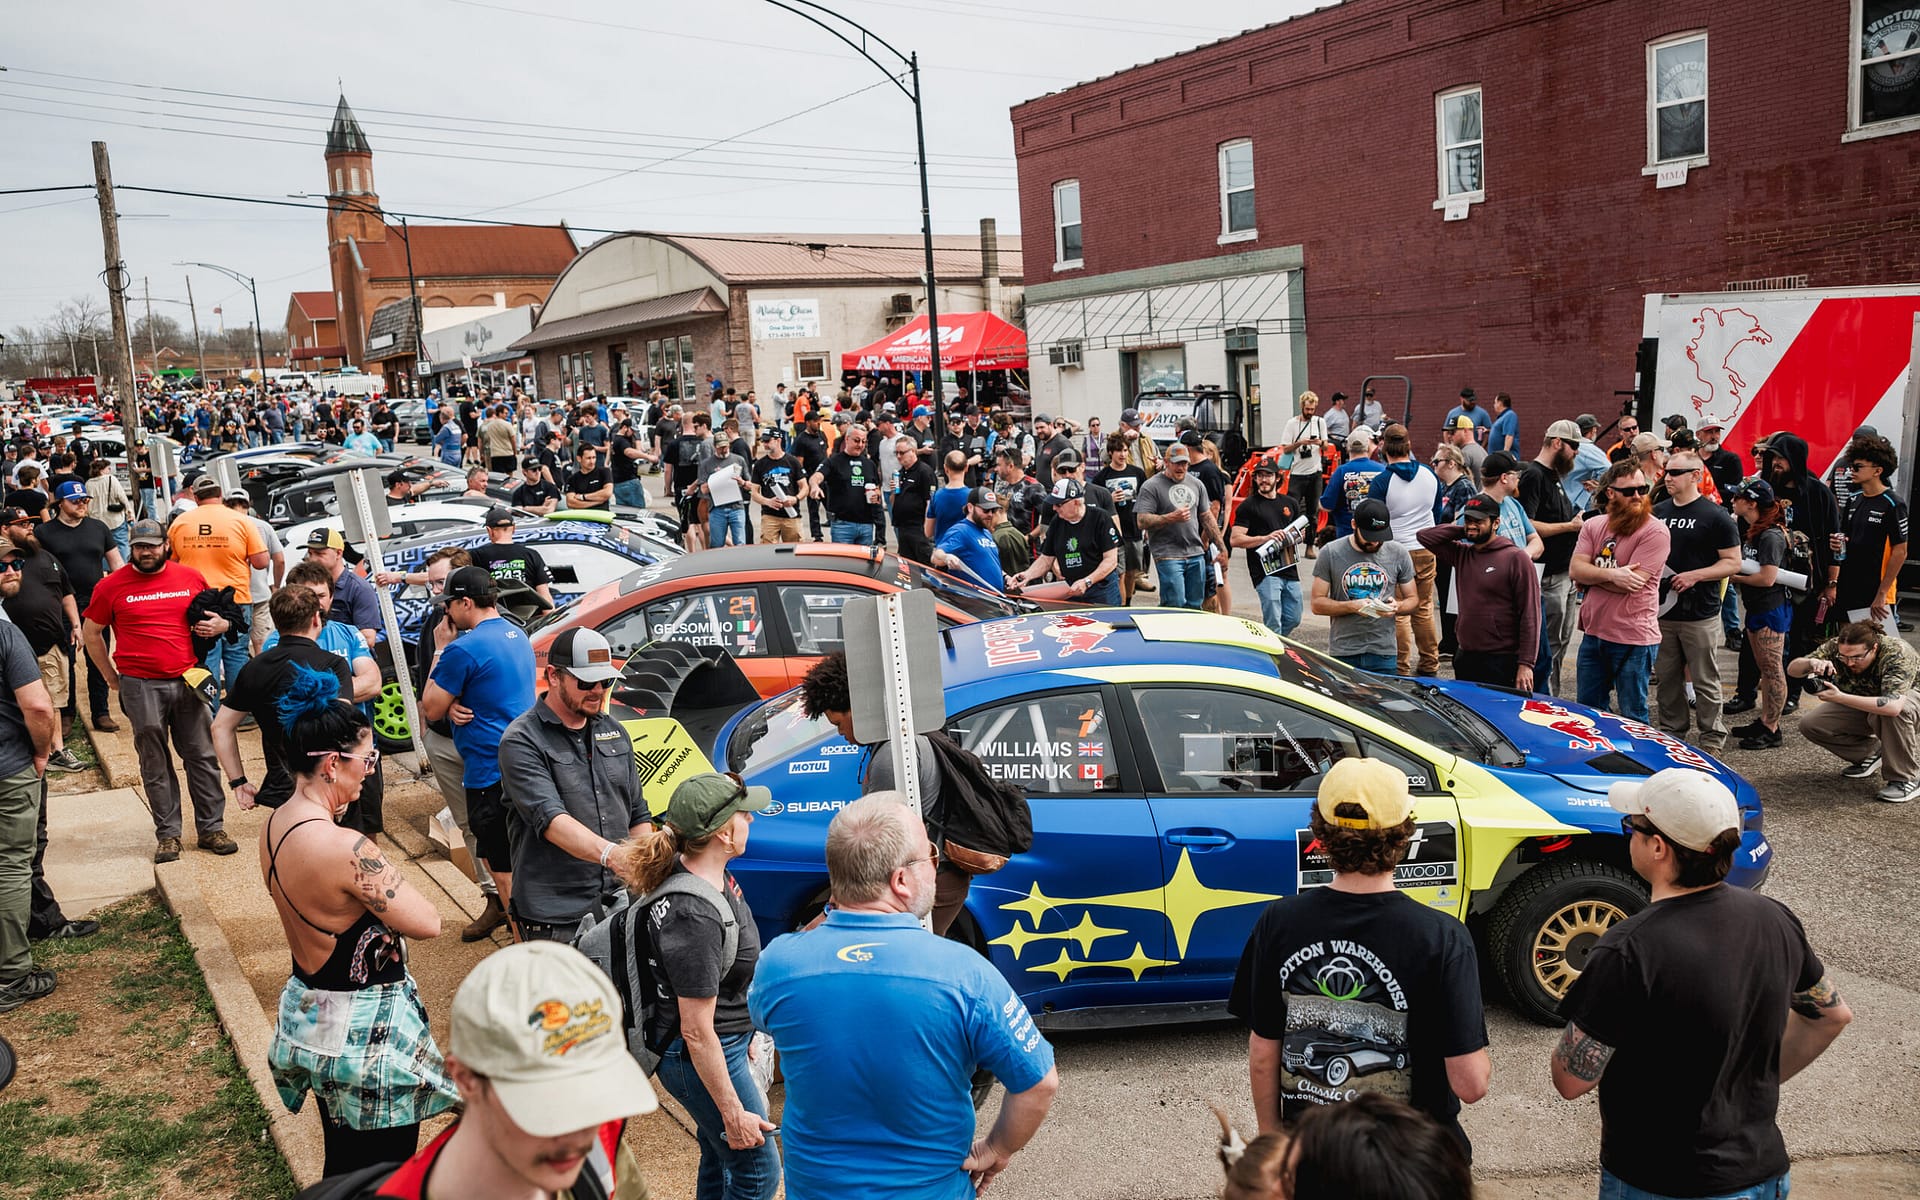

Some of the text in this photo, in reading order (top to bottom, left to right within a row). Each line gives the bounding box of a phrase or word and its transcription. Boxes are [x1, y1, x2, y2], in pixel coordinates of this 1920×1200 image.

[1660, 170, 1685, 180] MMA
[856, 356, 891, 370] ARA
[892, 355, 929, 364] AMERICAN
[421, 364, 428, 373] E
[199, 524, 213, 536] B
[1669, 518, 1697, 529] FOX
[729, 596, 756, 615] 21
[654, 621, 733, 635] GELSOMINO
[671, 634, 732, 646] MARTELL
[980, 741, 1072, 758] WILLIAMS
[656, 747, 693, 785] YOKOHAMA
[791, 762, 828, 772] MOTUL
[984, 763, 1072, 780] SEMENUK
[1400, 865, 1447, 878] WOOD
[1280, 940, 1409, 1011] OTTON WAREHOUSE
[1297, 1079, 1342, 1101] Classic
